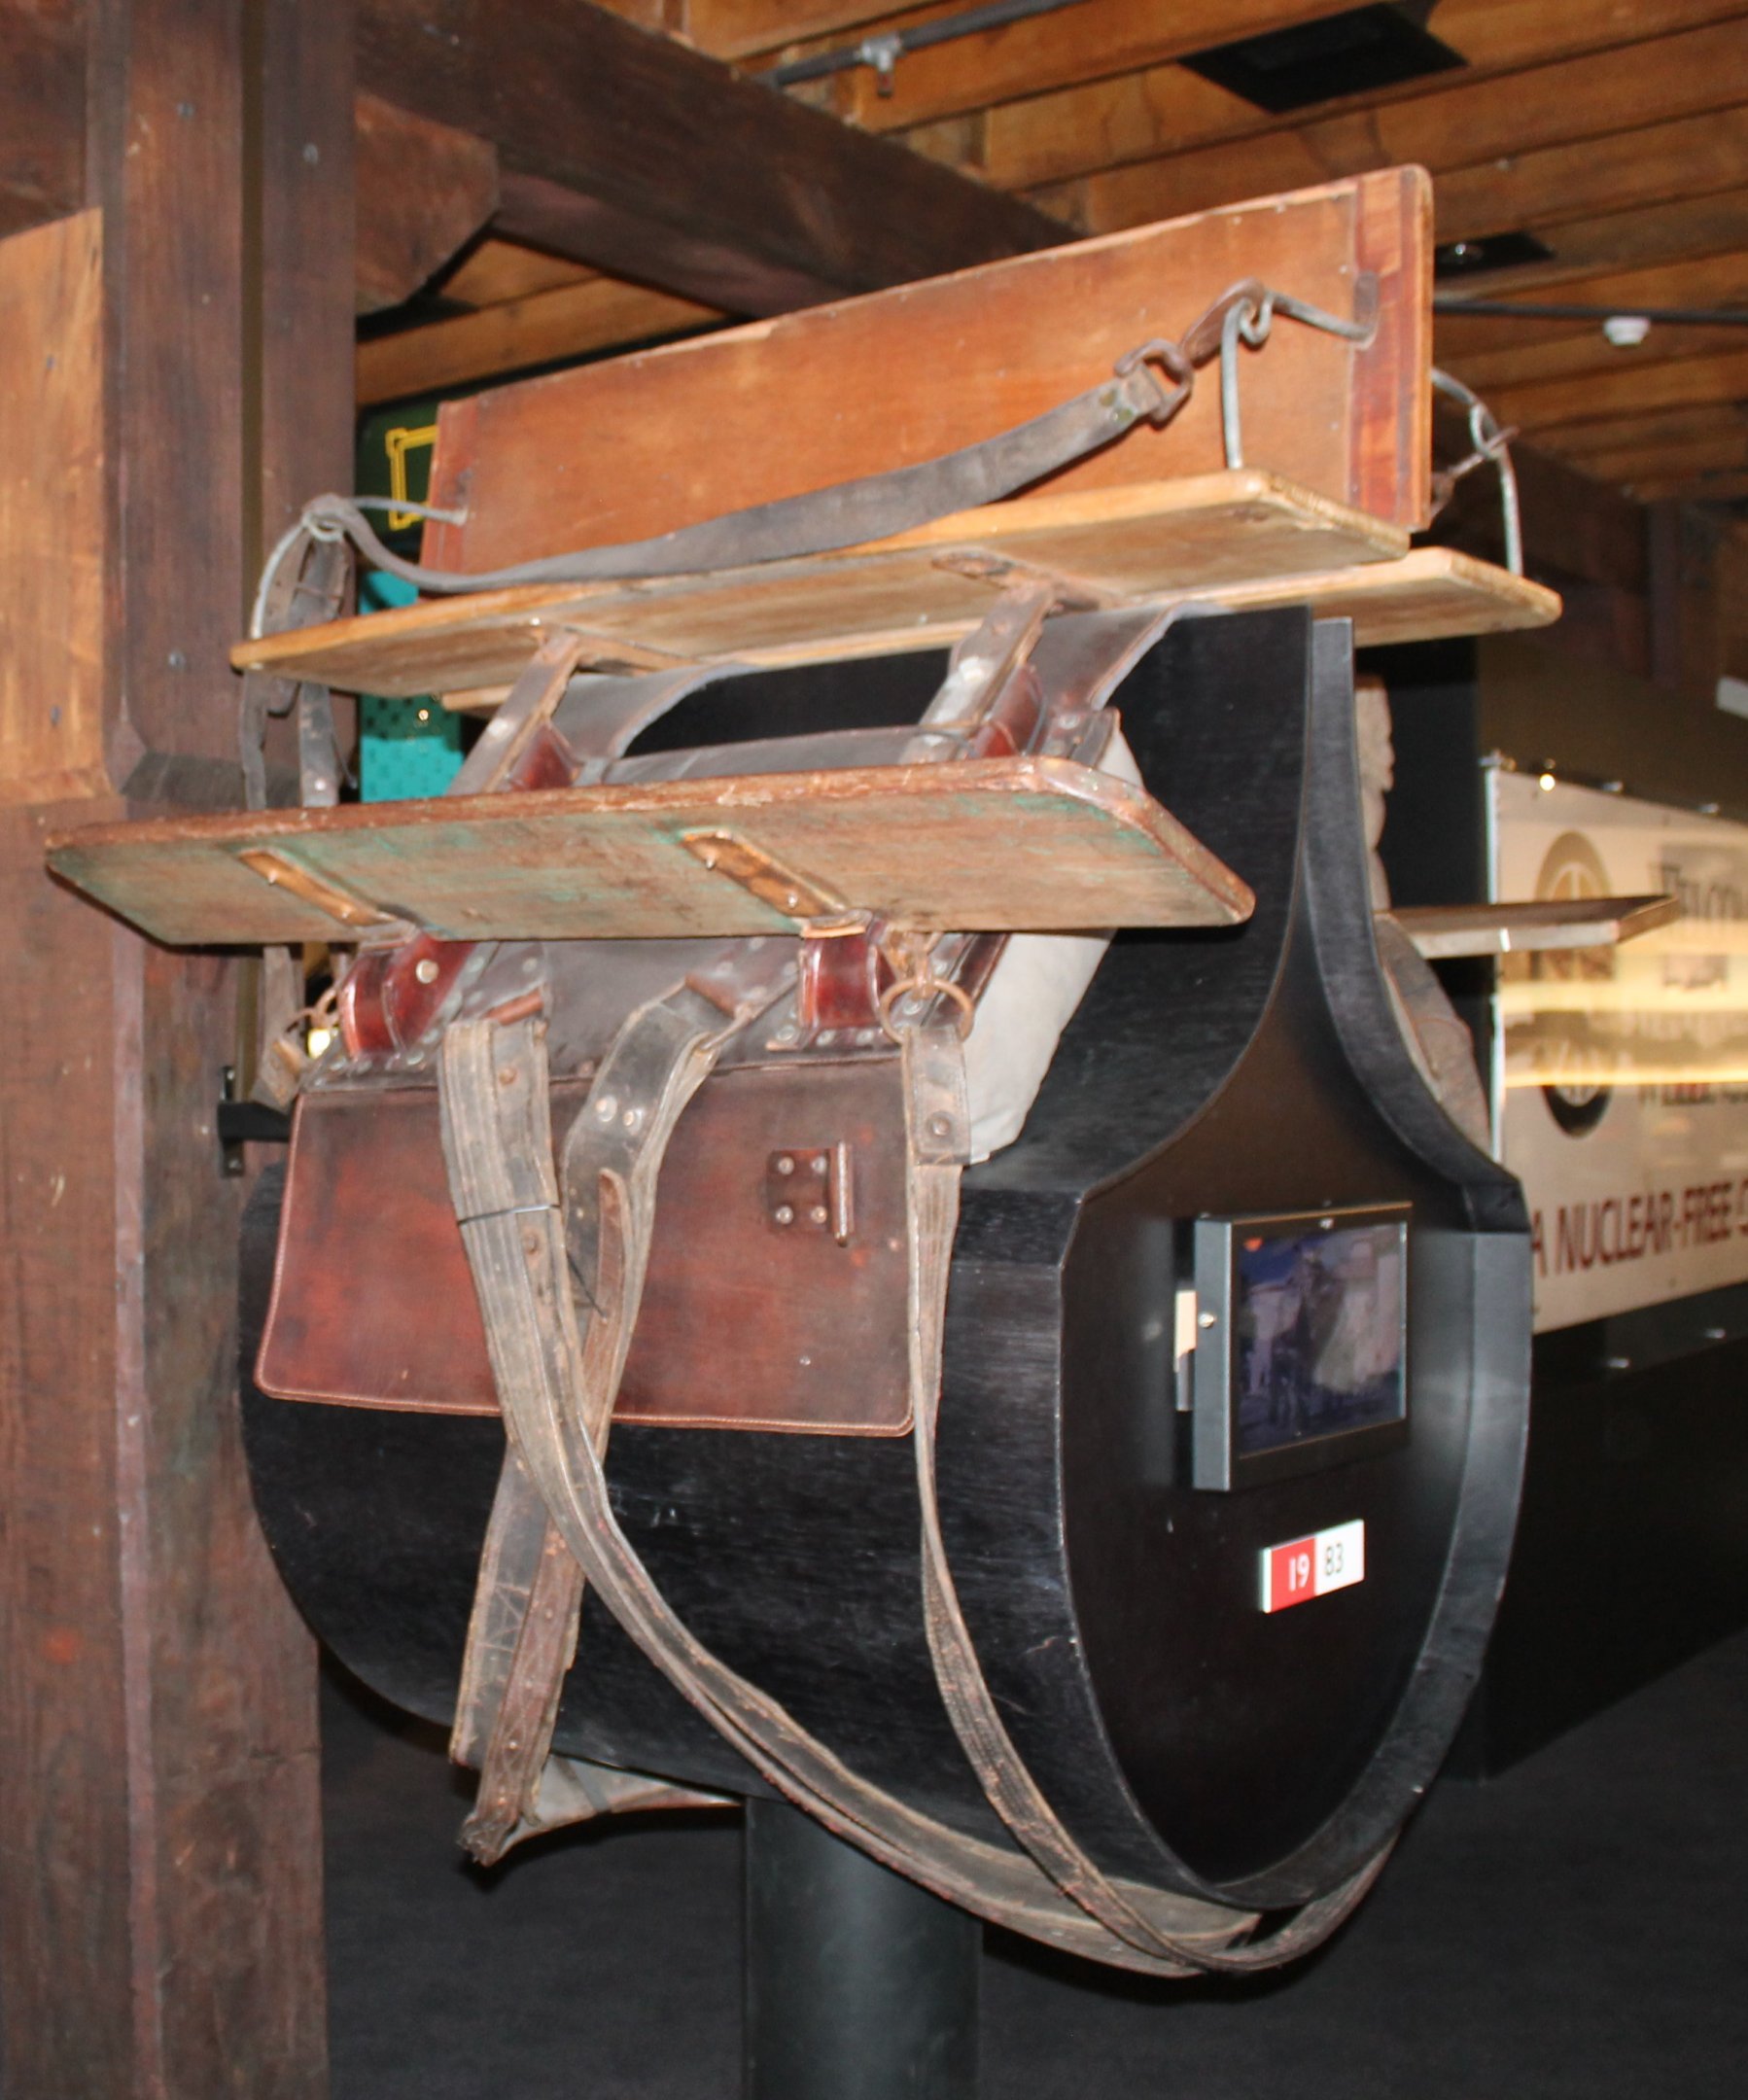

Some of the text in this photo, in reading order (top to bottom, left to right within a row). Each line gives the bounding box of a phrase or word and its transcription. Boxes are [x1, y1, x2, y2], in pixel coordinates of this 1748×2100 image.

[1532, 1209, 1546, 1278] A
[1556, 1181, 1731, 1276] NUCLEAR-FREE
[1288, 1542, 1344, 1592] 19 83
